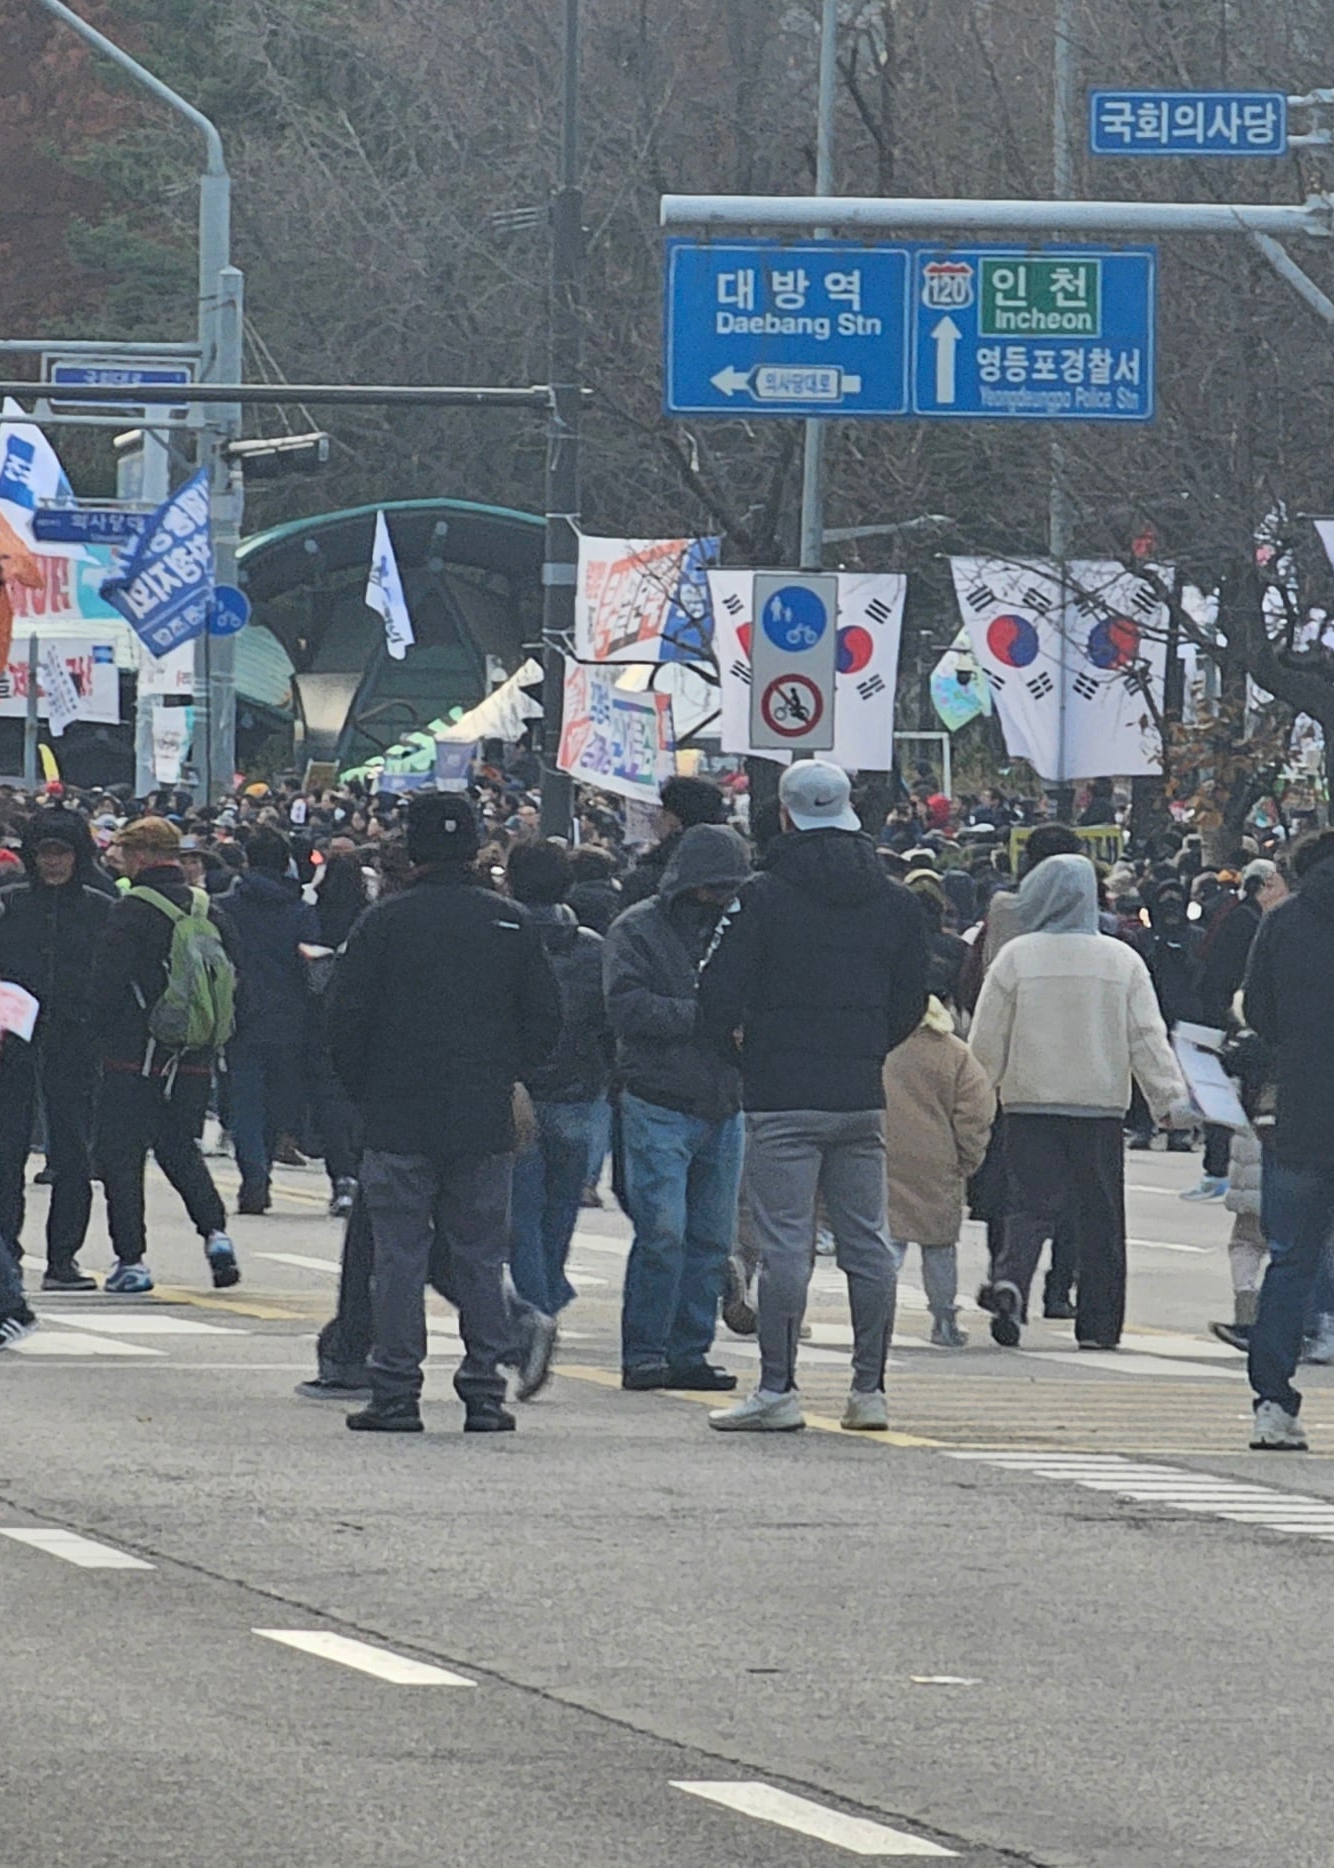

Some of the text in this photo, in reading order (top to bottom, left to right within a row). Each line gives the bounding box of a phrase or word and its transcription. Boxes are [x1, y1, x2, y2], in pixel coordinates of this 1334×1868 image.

[1100, 101, 1277, 144] 국회의사당
[717, 268, 861, 311] 대방역
[930, 276, 966, 304] 120
[717, 311, 881, 340] Daebang Stn
[995, 308, 1092, 331] Incheon
[976, 347, 1140, 386] 영등포경찰서
[765, 371, 833, 394] 의사당대로
[1075, 386, 1112, 408] Police
[1117, 386, 1139, 409] Stn
